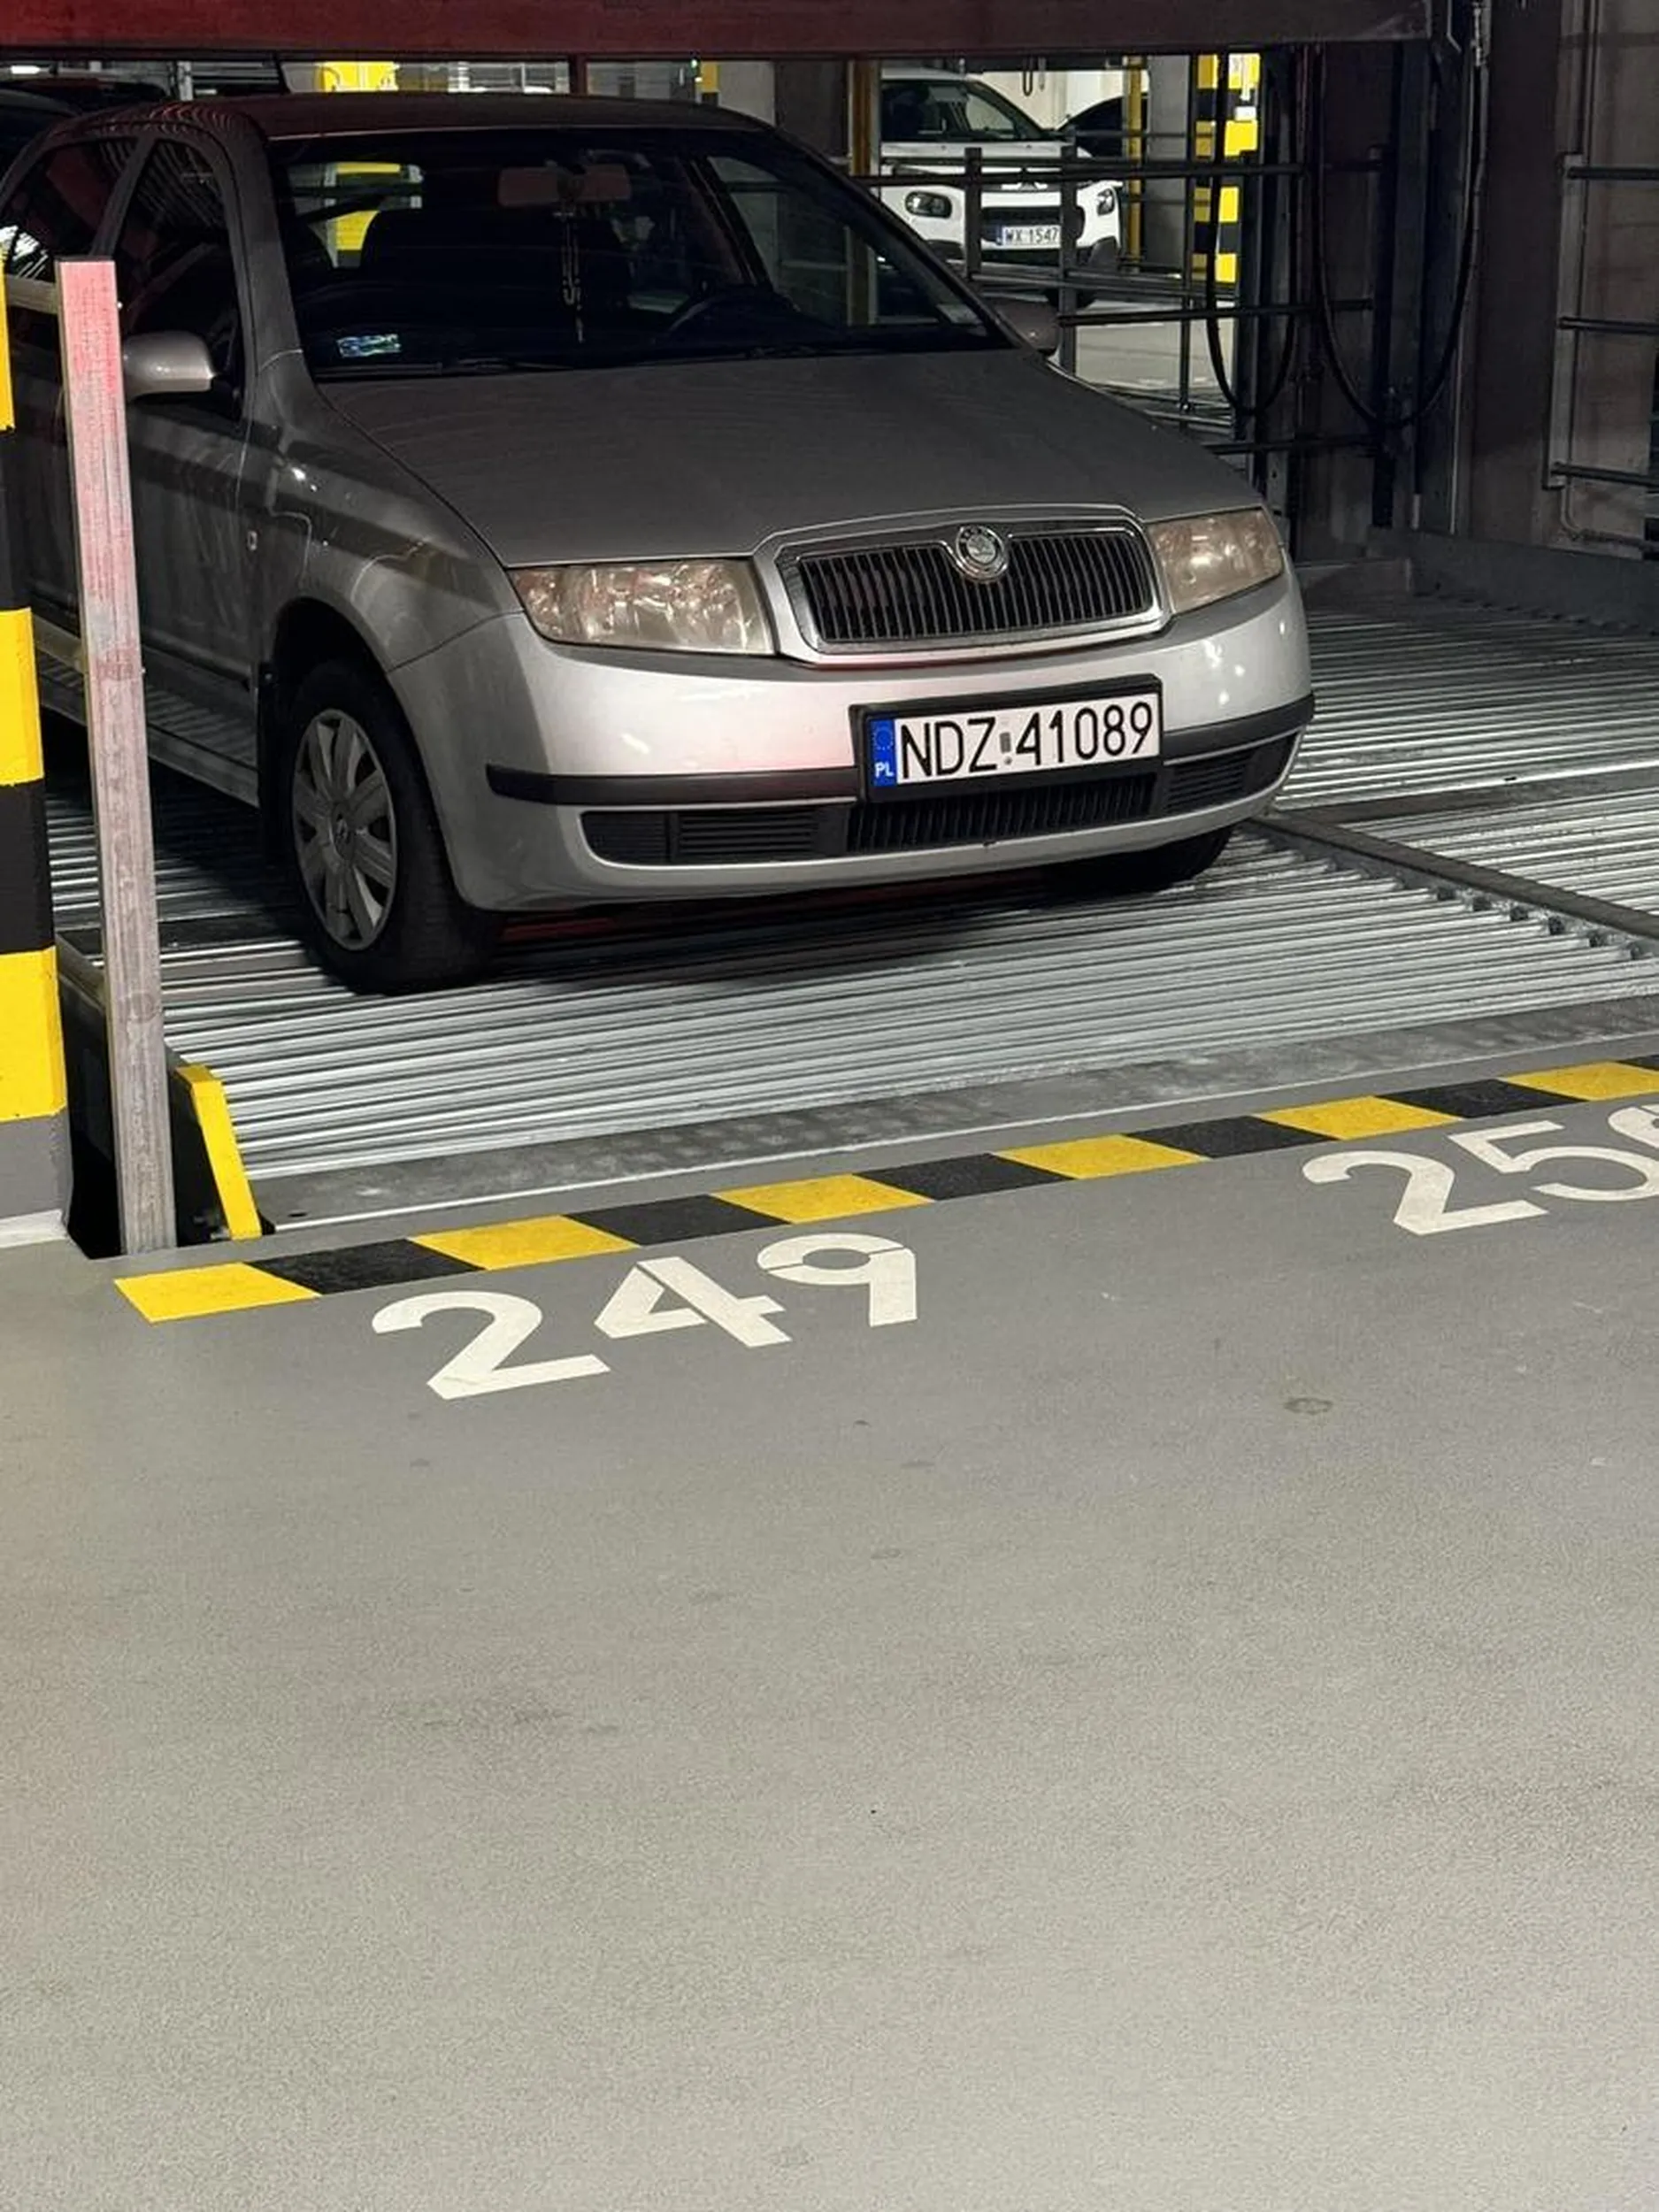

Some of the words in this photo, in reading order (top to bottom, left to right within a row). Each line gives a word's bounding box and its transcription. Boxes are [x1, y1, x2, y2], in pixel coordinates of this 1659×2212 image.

[1005, 228, 1023, 242] WX
[900, 716, 998, 780] NDZ
[1015, 701, 1153, 766] 41089
[874, 762, 895, 778] PL
[372, 1233, 918, 1400] 249
